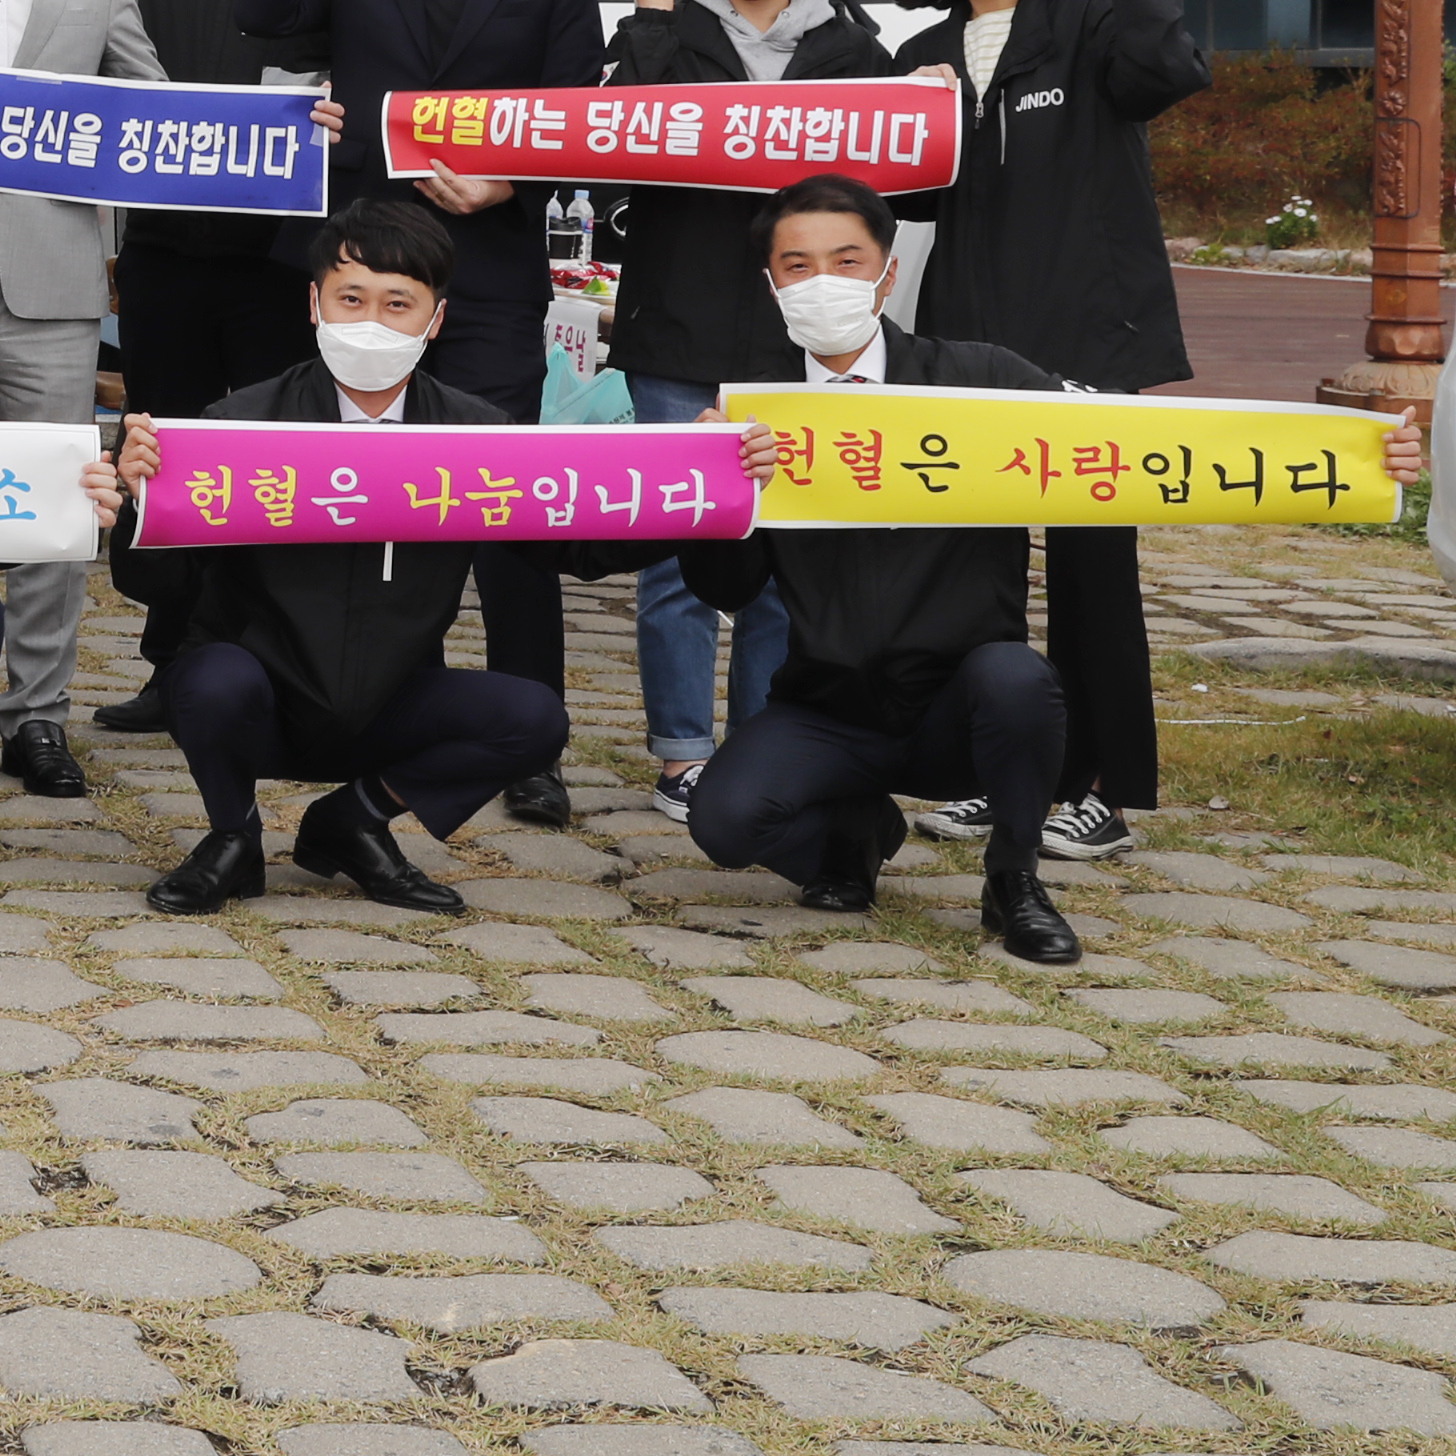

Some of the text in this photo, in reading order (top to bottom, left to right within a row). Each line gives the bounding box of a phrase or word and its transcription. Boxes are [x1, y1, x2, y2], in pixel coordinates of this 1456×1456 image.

[411, 96, 929, 167] 헌혈하는 당신을 칭찬합니다
[1015, 87, 1065, 113] JINDO
[0, 106, 103, 169] 당신을
[118, 118, 300, 180] 칭찬합니다
[184, 464, 716, 528] 헌혈은 나눔입니다
[774, 426, 1352, 510] 헌혈은 사랑입니다
